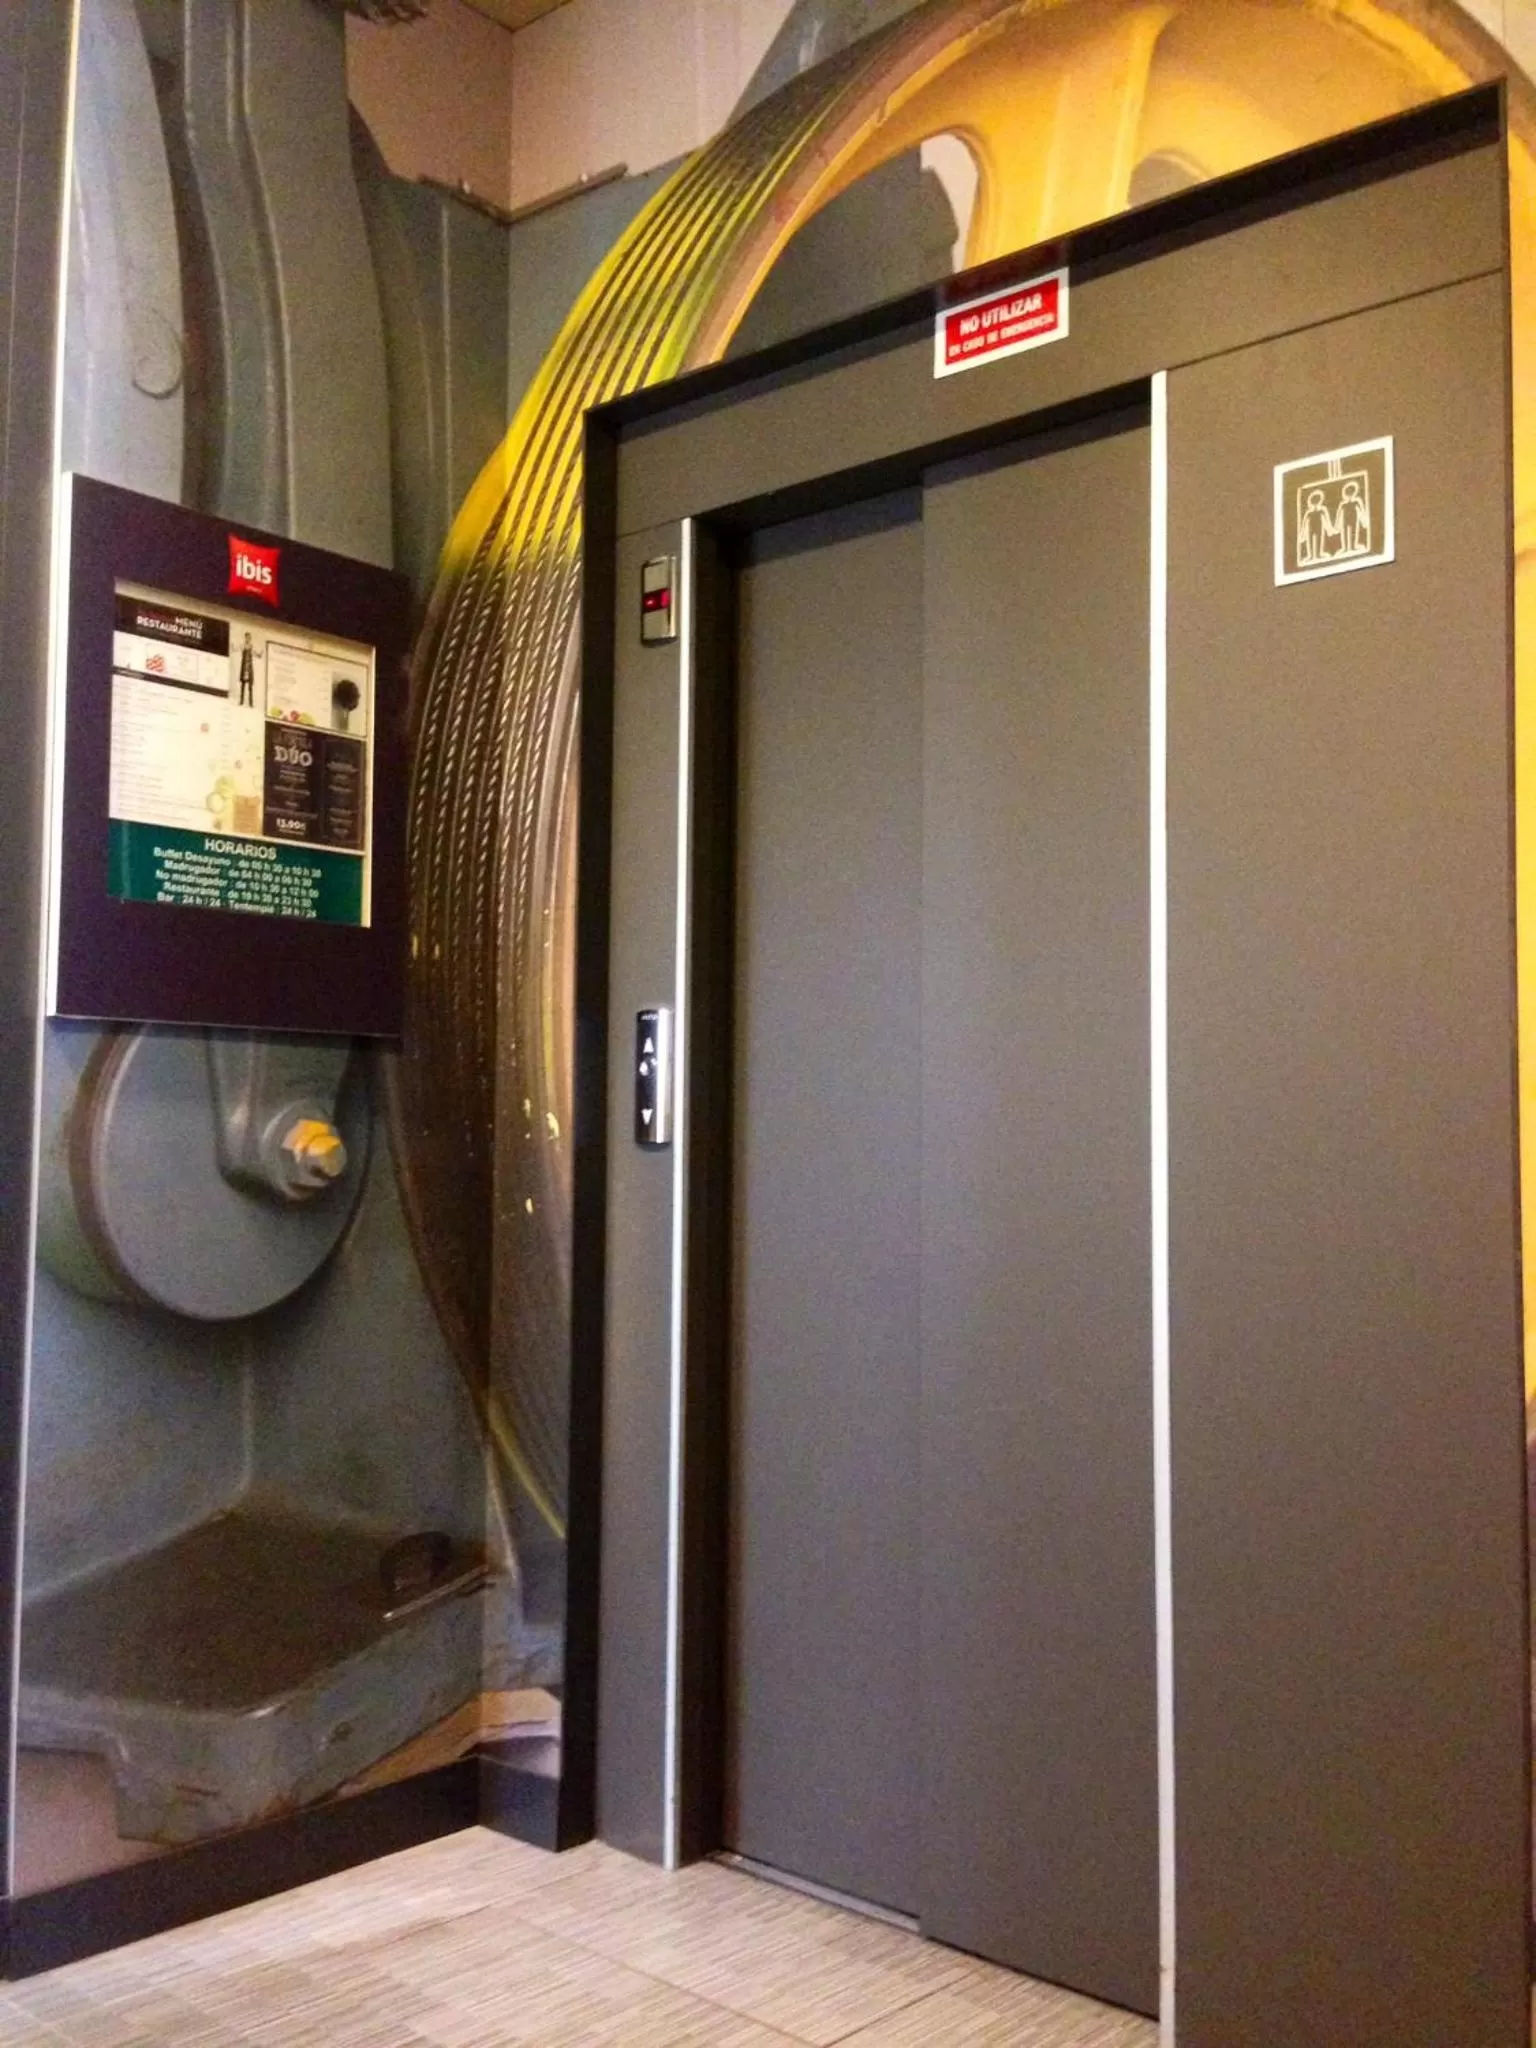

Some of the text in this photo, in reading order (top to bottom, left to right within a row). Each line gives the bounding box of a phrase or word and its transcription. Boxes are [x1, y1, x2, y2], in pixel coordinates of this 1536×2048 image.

[960, 293, 1042, 336] NO UTILIZAR
[236, 553, 272, 584] ibis
[136, 615, 203, 640] RESTAURANTE
[153, 846, 182, 859] Buffet
[204, 838, 277, 860] HORARIOS
[156, 891, 175, 902] Bar
